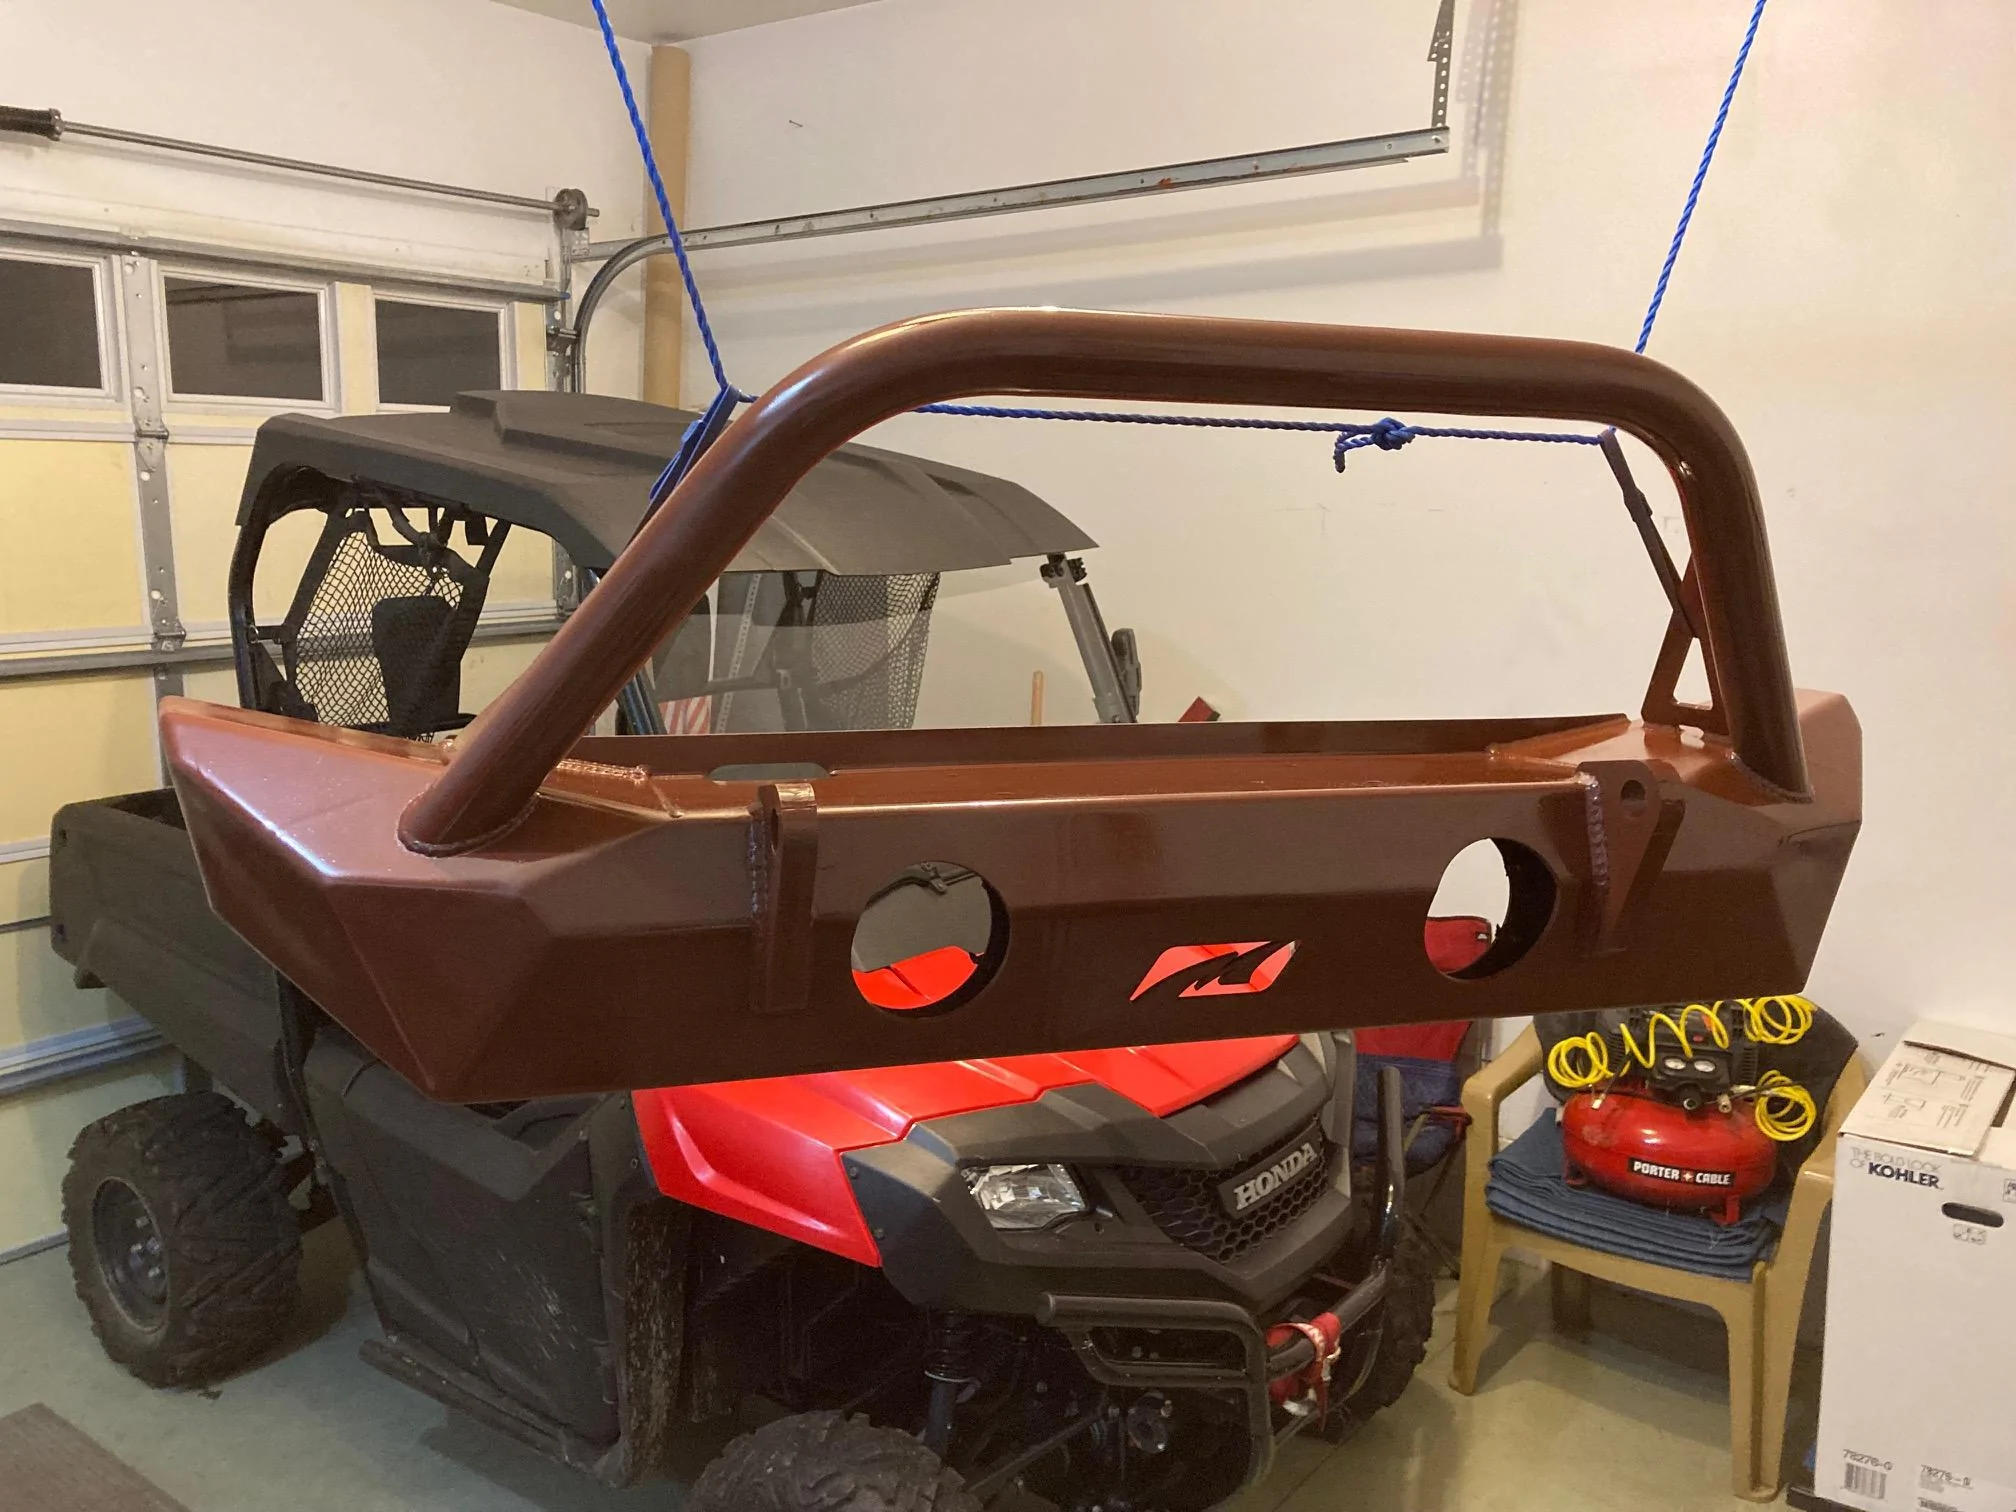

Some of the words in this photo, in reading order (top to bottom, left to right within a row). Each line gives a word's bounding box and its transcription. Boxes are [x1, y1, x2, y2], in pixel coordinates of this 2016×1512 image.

[1234, 1142, 1318, 1211] HONDA
[1633, 1160, 1680, 1180] PORTER
[1695, 1172, 1732, 1185] CABLE
[1868, 1162, 1940, 1188] KOHLER
